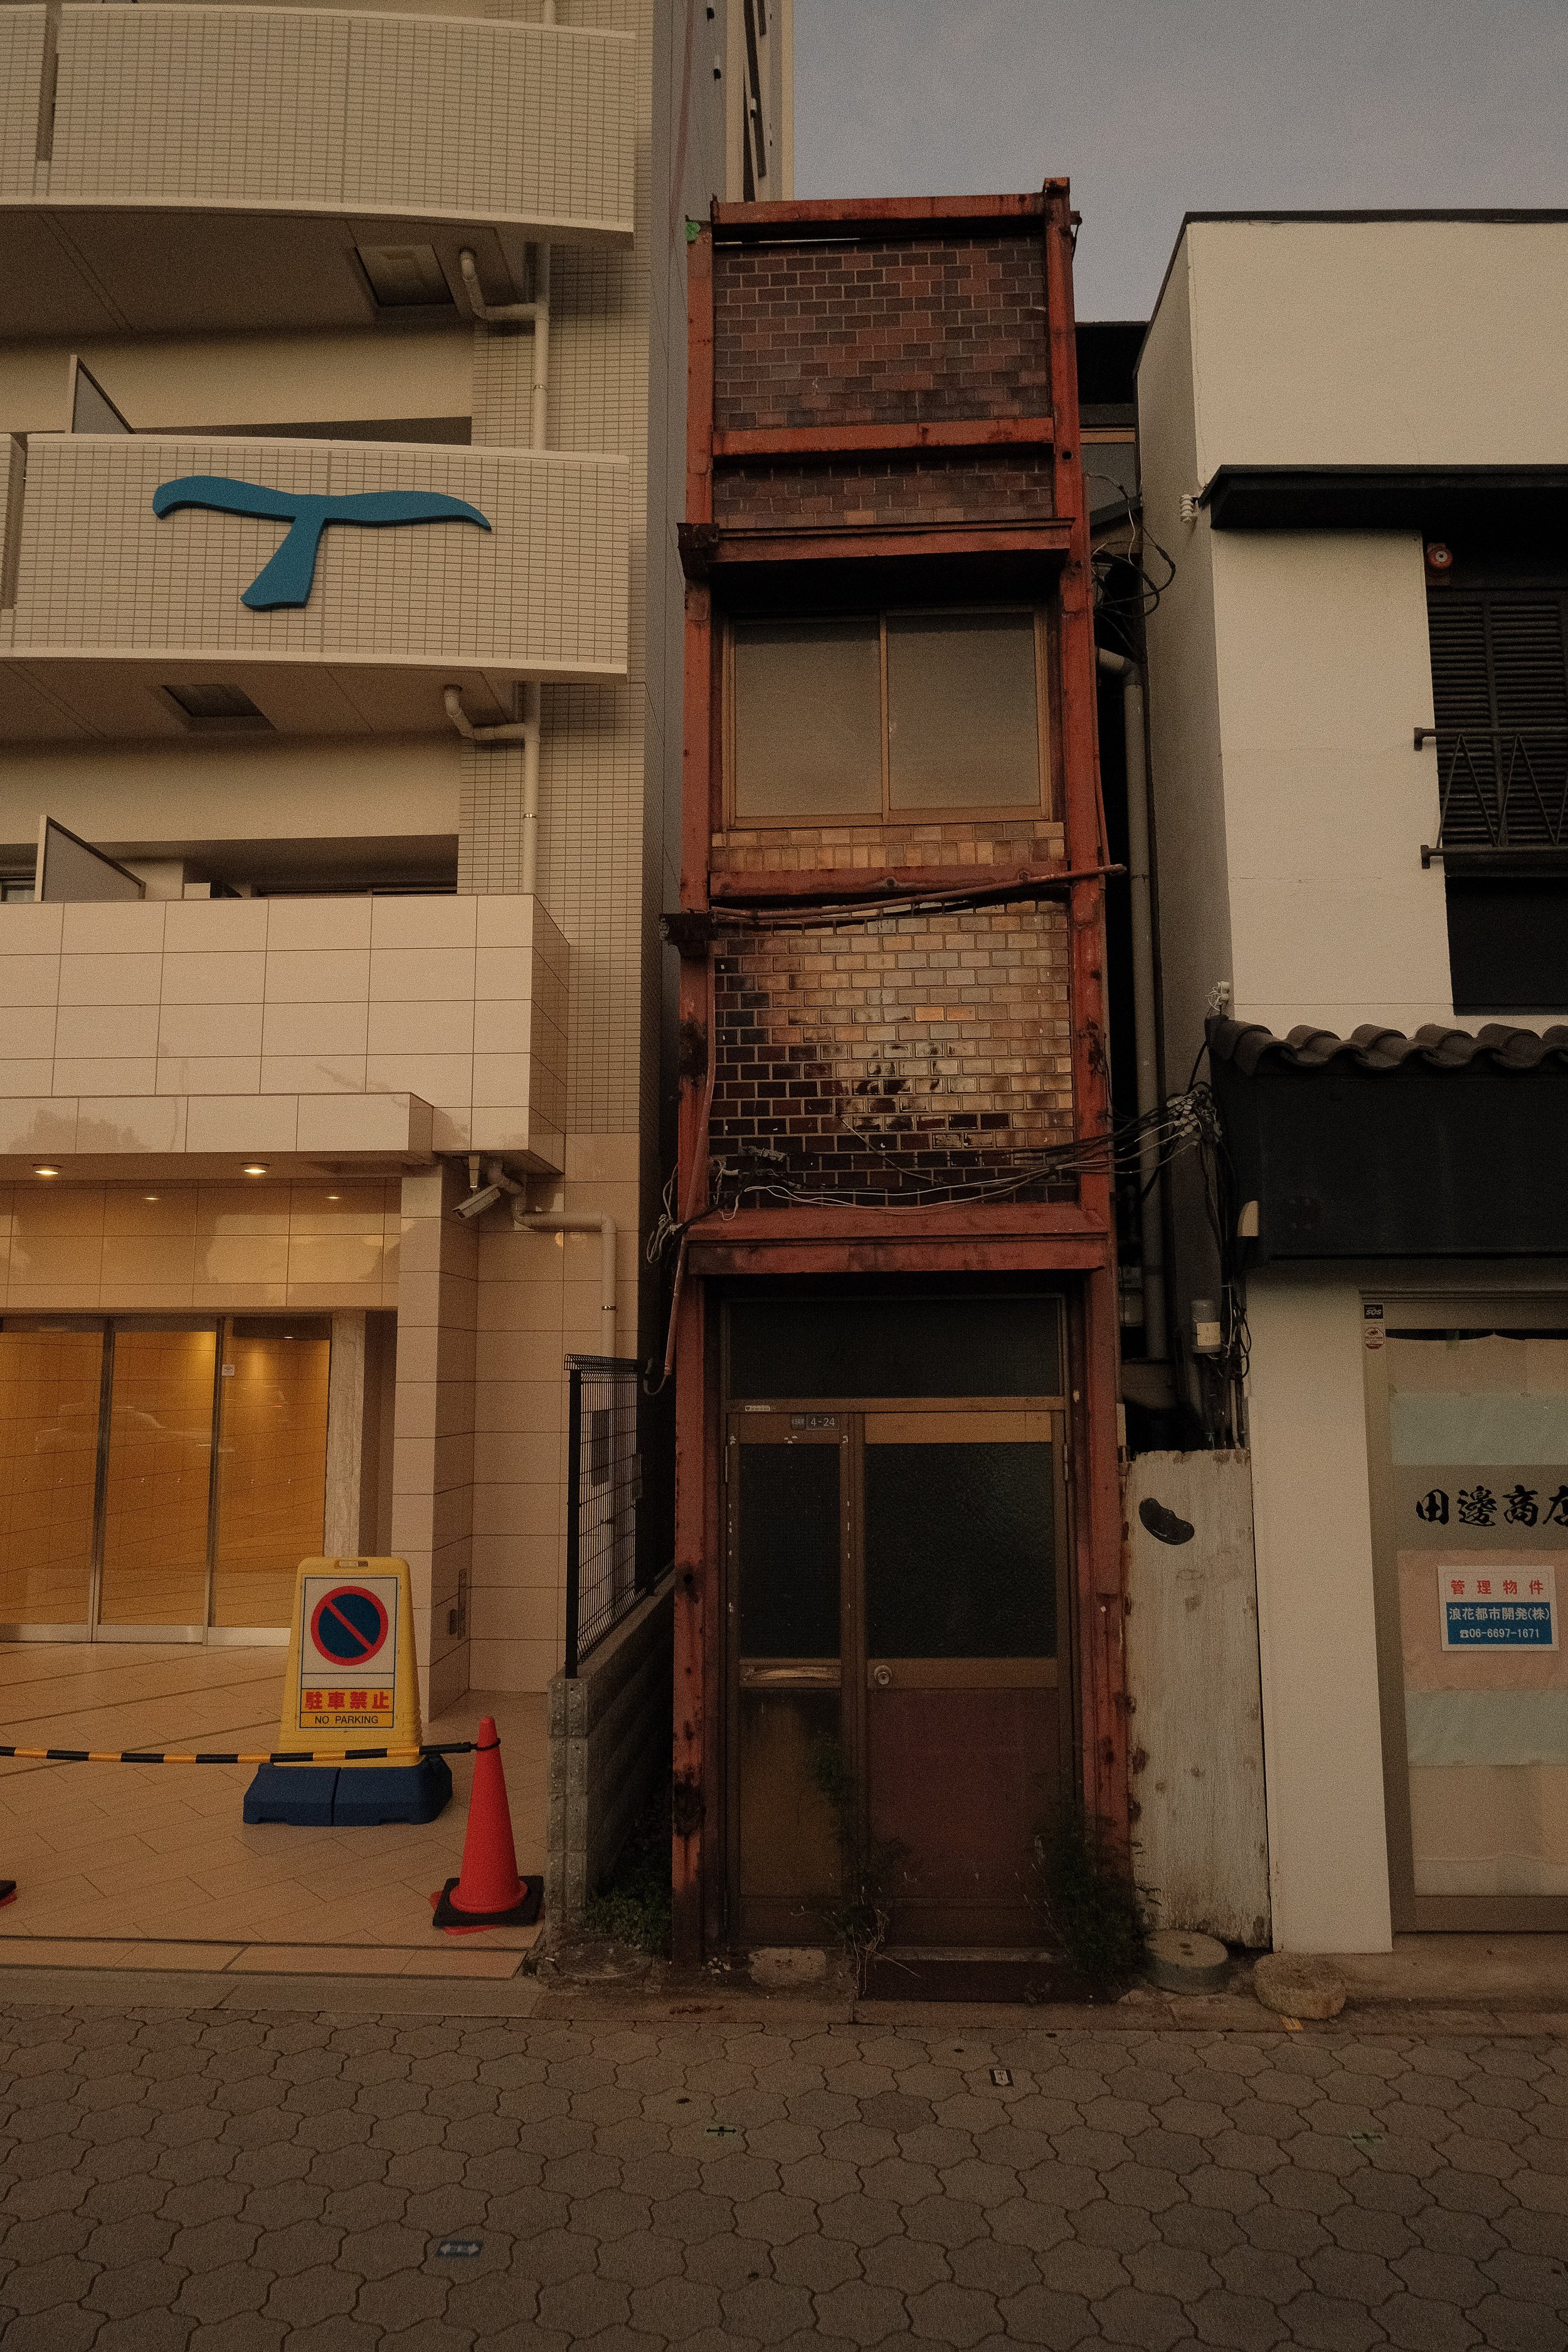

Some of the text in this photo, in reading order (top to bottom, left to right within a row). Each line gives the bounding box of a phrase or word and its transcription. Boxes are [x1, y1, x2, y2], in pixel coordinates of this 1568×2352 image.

[810, 1417, 835, 1427] 4-24
[1451, 1579, 1544, 1595] 管理物件
[1449, 1607, 1550, 1621] 浪花都市開発(株)
[305, 1691, 389, 1710] 駐車禁止
[315, 1715, 378, 1724] NO PARKING
